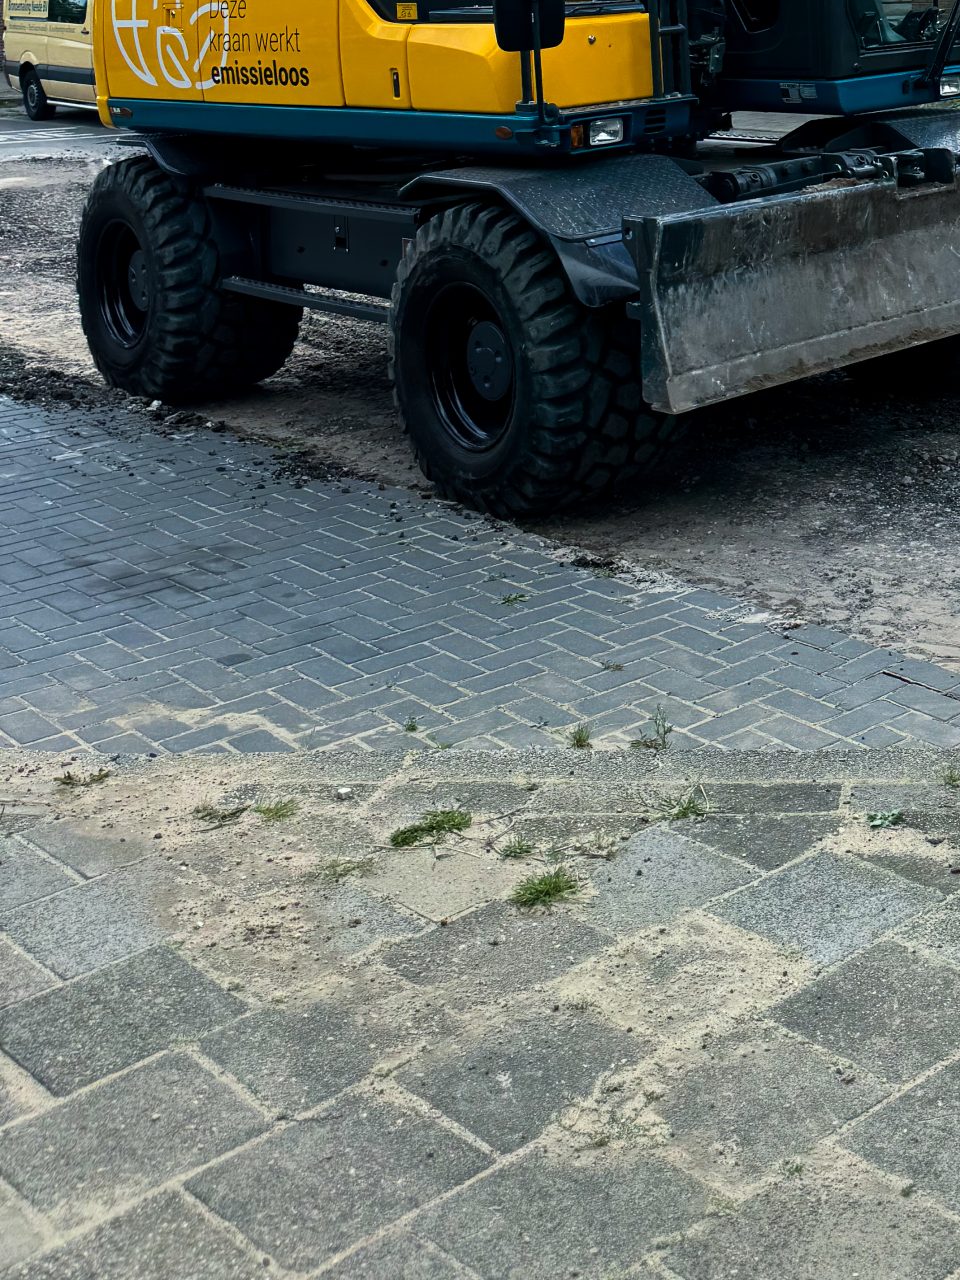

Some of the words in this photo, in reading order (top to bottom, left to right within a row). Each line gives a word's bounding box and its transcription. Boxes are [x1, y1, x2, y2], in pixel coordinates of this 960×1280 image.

[210, 26, 250, 52] kraan
[255, 24, 300, 52] werkt
[212, 60, 309, 86] emissieloos
